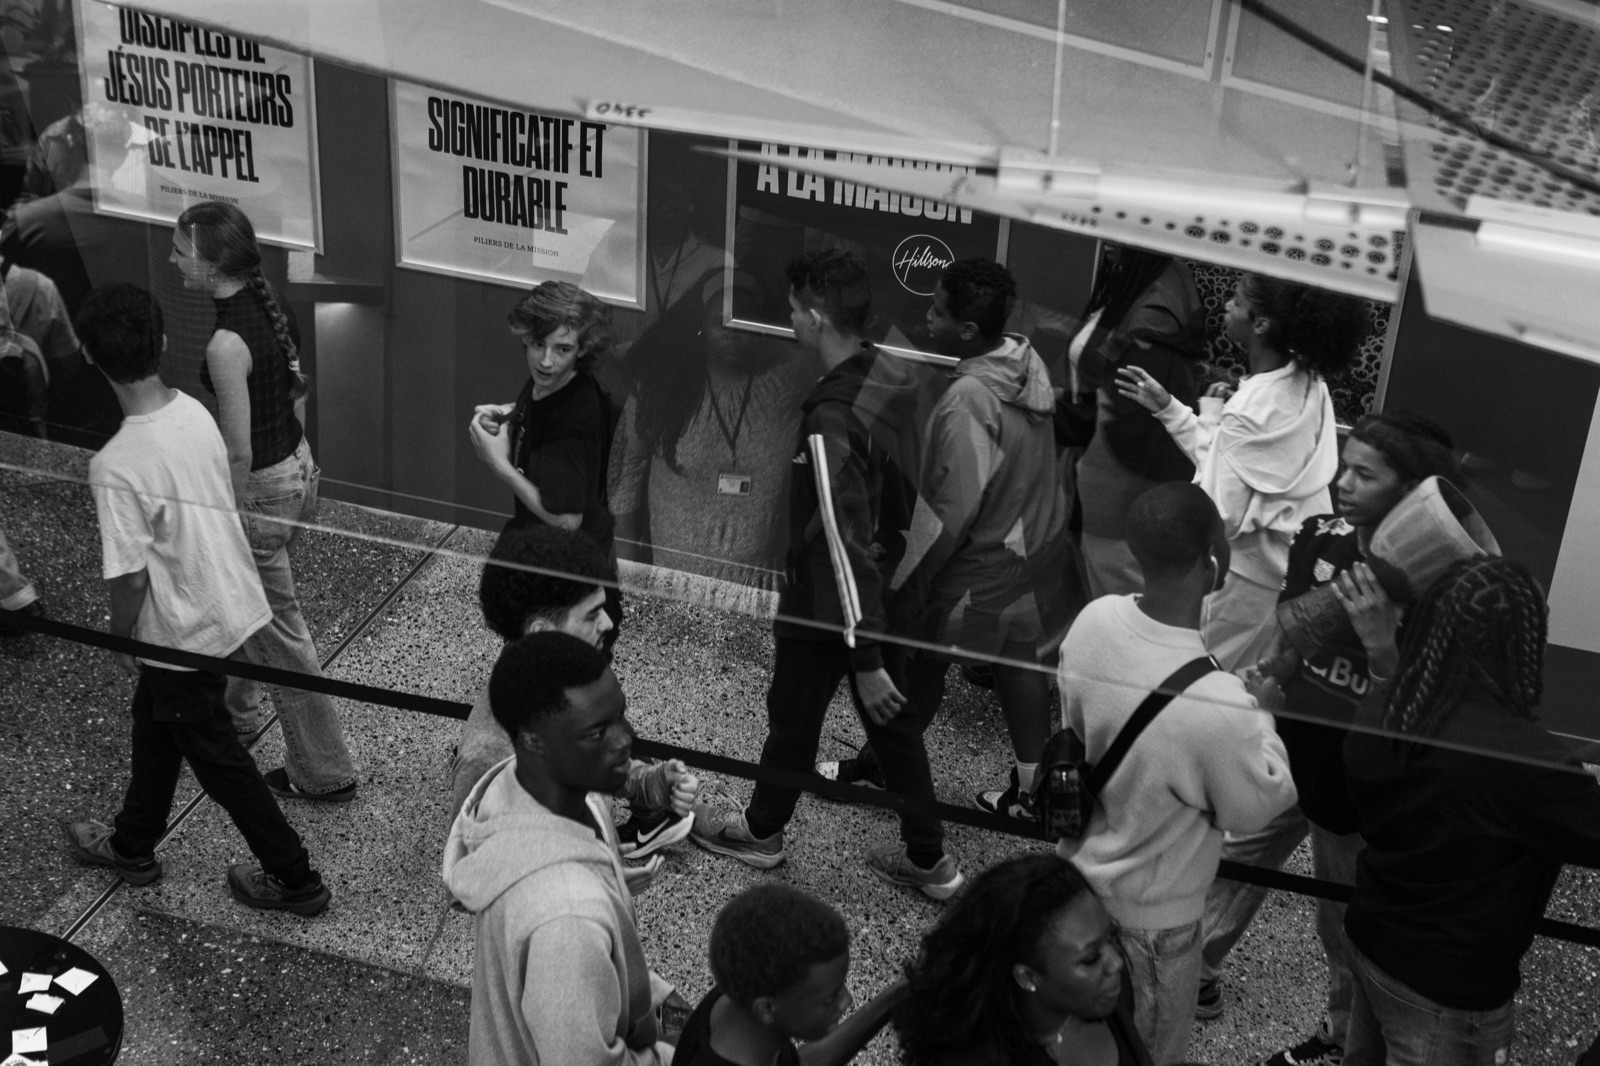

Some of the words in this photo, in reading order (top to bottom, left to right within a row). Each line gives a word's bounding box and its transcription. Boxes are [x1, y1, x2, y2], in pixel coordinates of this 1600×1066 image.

[104, 45, 172, 111] JÉSUS
[175, 60, 294, 128] PORTEURS
[144, 115, 175, 168] DE
[428, 96, 574, 174] SIGNIFICATIF
[579, 121, 606, 178] ET
[160, 185, 187, 195] PILIERS
[188, 189, 198, 198] DE
[199, 192, 208, 200] LA
[209, 193, 238, 204] MISSION
[463, 165, 568, 235] DURABLE
[473, 236, 502, 247] PILIERS
[504, 241, 514, 249] DE
[516, 243, 526, 251] LA
[527, 245, 559, 257] MISSION
